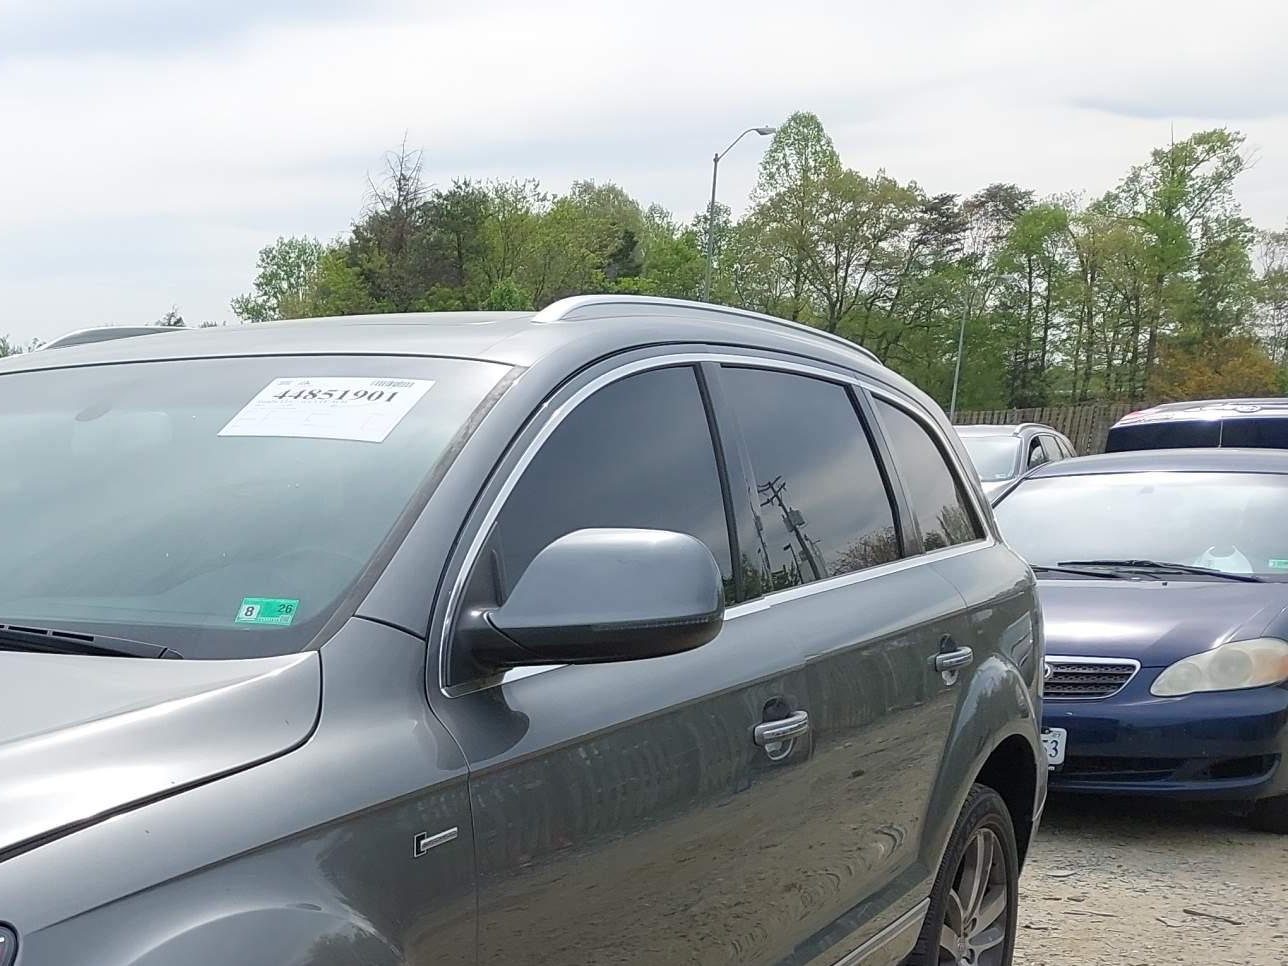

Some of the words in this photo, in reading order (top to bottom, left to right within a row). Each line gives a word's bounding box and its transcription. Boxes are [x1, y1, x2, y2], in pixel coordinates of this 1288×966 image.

[272, 389, 399, 402] 44851901
[244, 606, 255, 617] 8
[277, 604, 294, 614] 26
